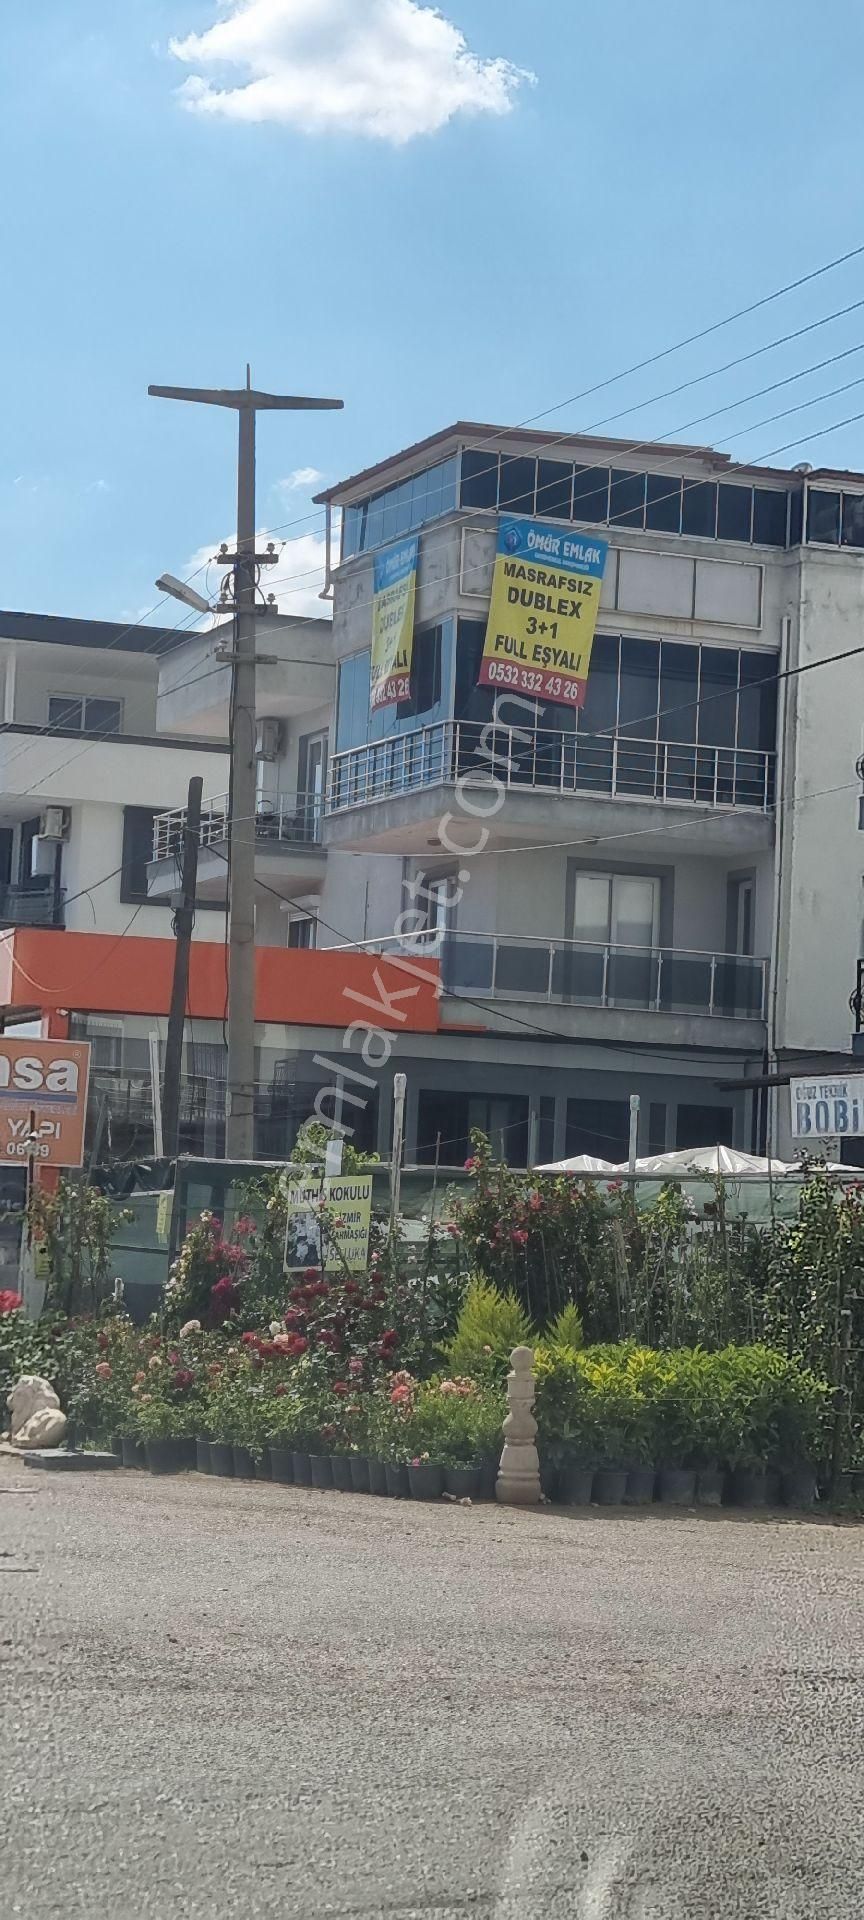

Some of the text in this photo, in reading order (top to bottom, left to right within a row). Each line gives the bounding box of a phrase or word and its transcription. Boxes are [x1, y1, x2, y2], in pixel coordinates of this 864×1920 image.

[527, 529, 561, 555] ÖMÜR
[563, 541, 601, 564] EMLAK
[503, 562, 593, 596] MASRAFSIZ
[507, 586, 583, 619] DUBLEX
[525, 616, 559, 640] 3+1
[494, 634, 582, 672] FULL EŞYALI
[387, 681, 397, 699] 43
[398, 678, 410, 697] 26
[488, 662, 578, 700] 0532 332 43 26
[329, 1185, 370, 1201] KOKULU
